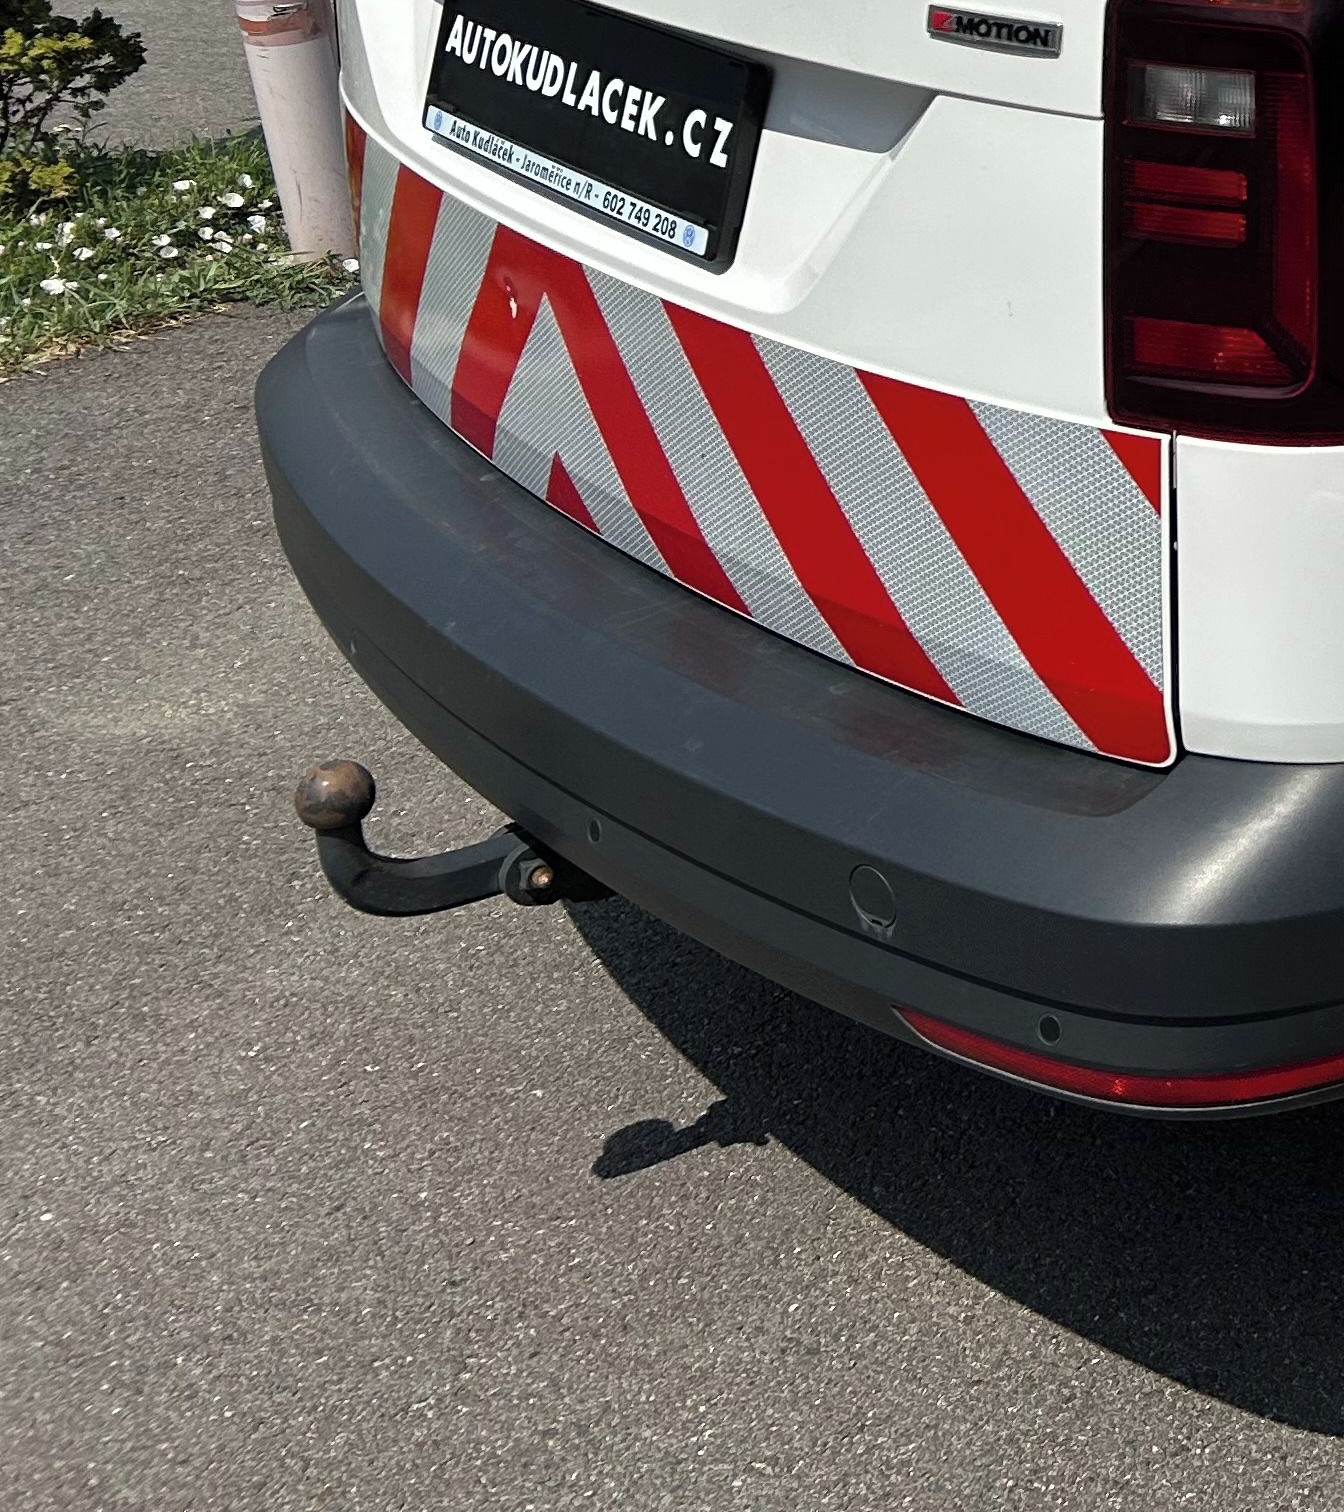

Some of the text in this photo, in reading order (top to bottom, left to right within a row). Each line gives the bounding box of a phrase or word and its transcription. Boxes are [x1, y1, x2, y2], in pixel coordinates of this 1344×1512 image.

[445, 14, 733, 168] AUTOKUDLACEK.CZ
[449, 120, 471, 144] Auto
[471, 129, 514, 164] Kudláček
[602, 190, 626, 217] 602
[627, 201, 651, 228] 749
[652, 213, 678, 240] 208
